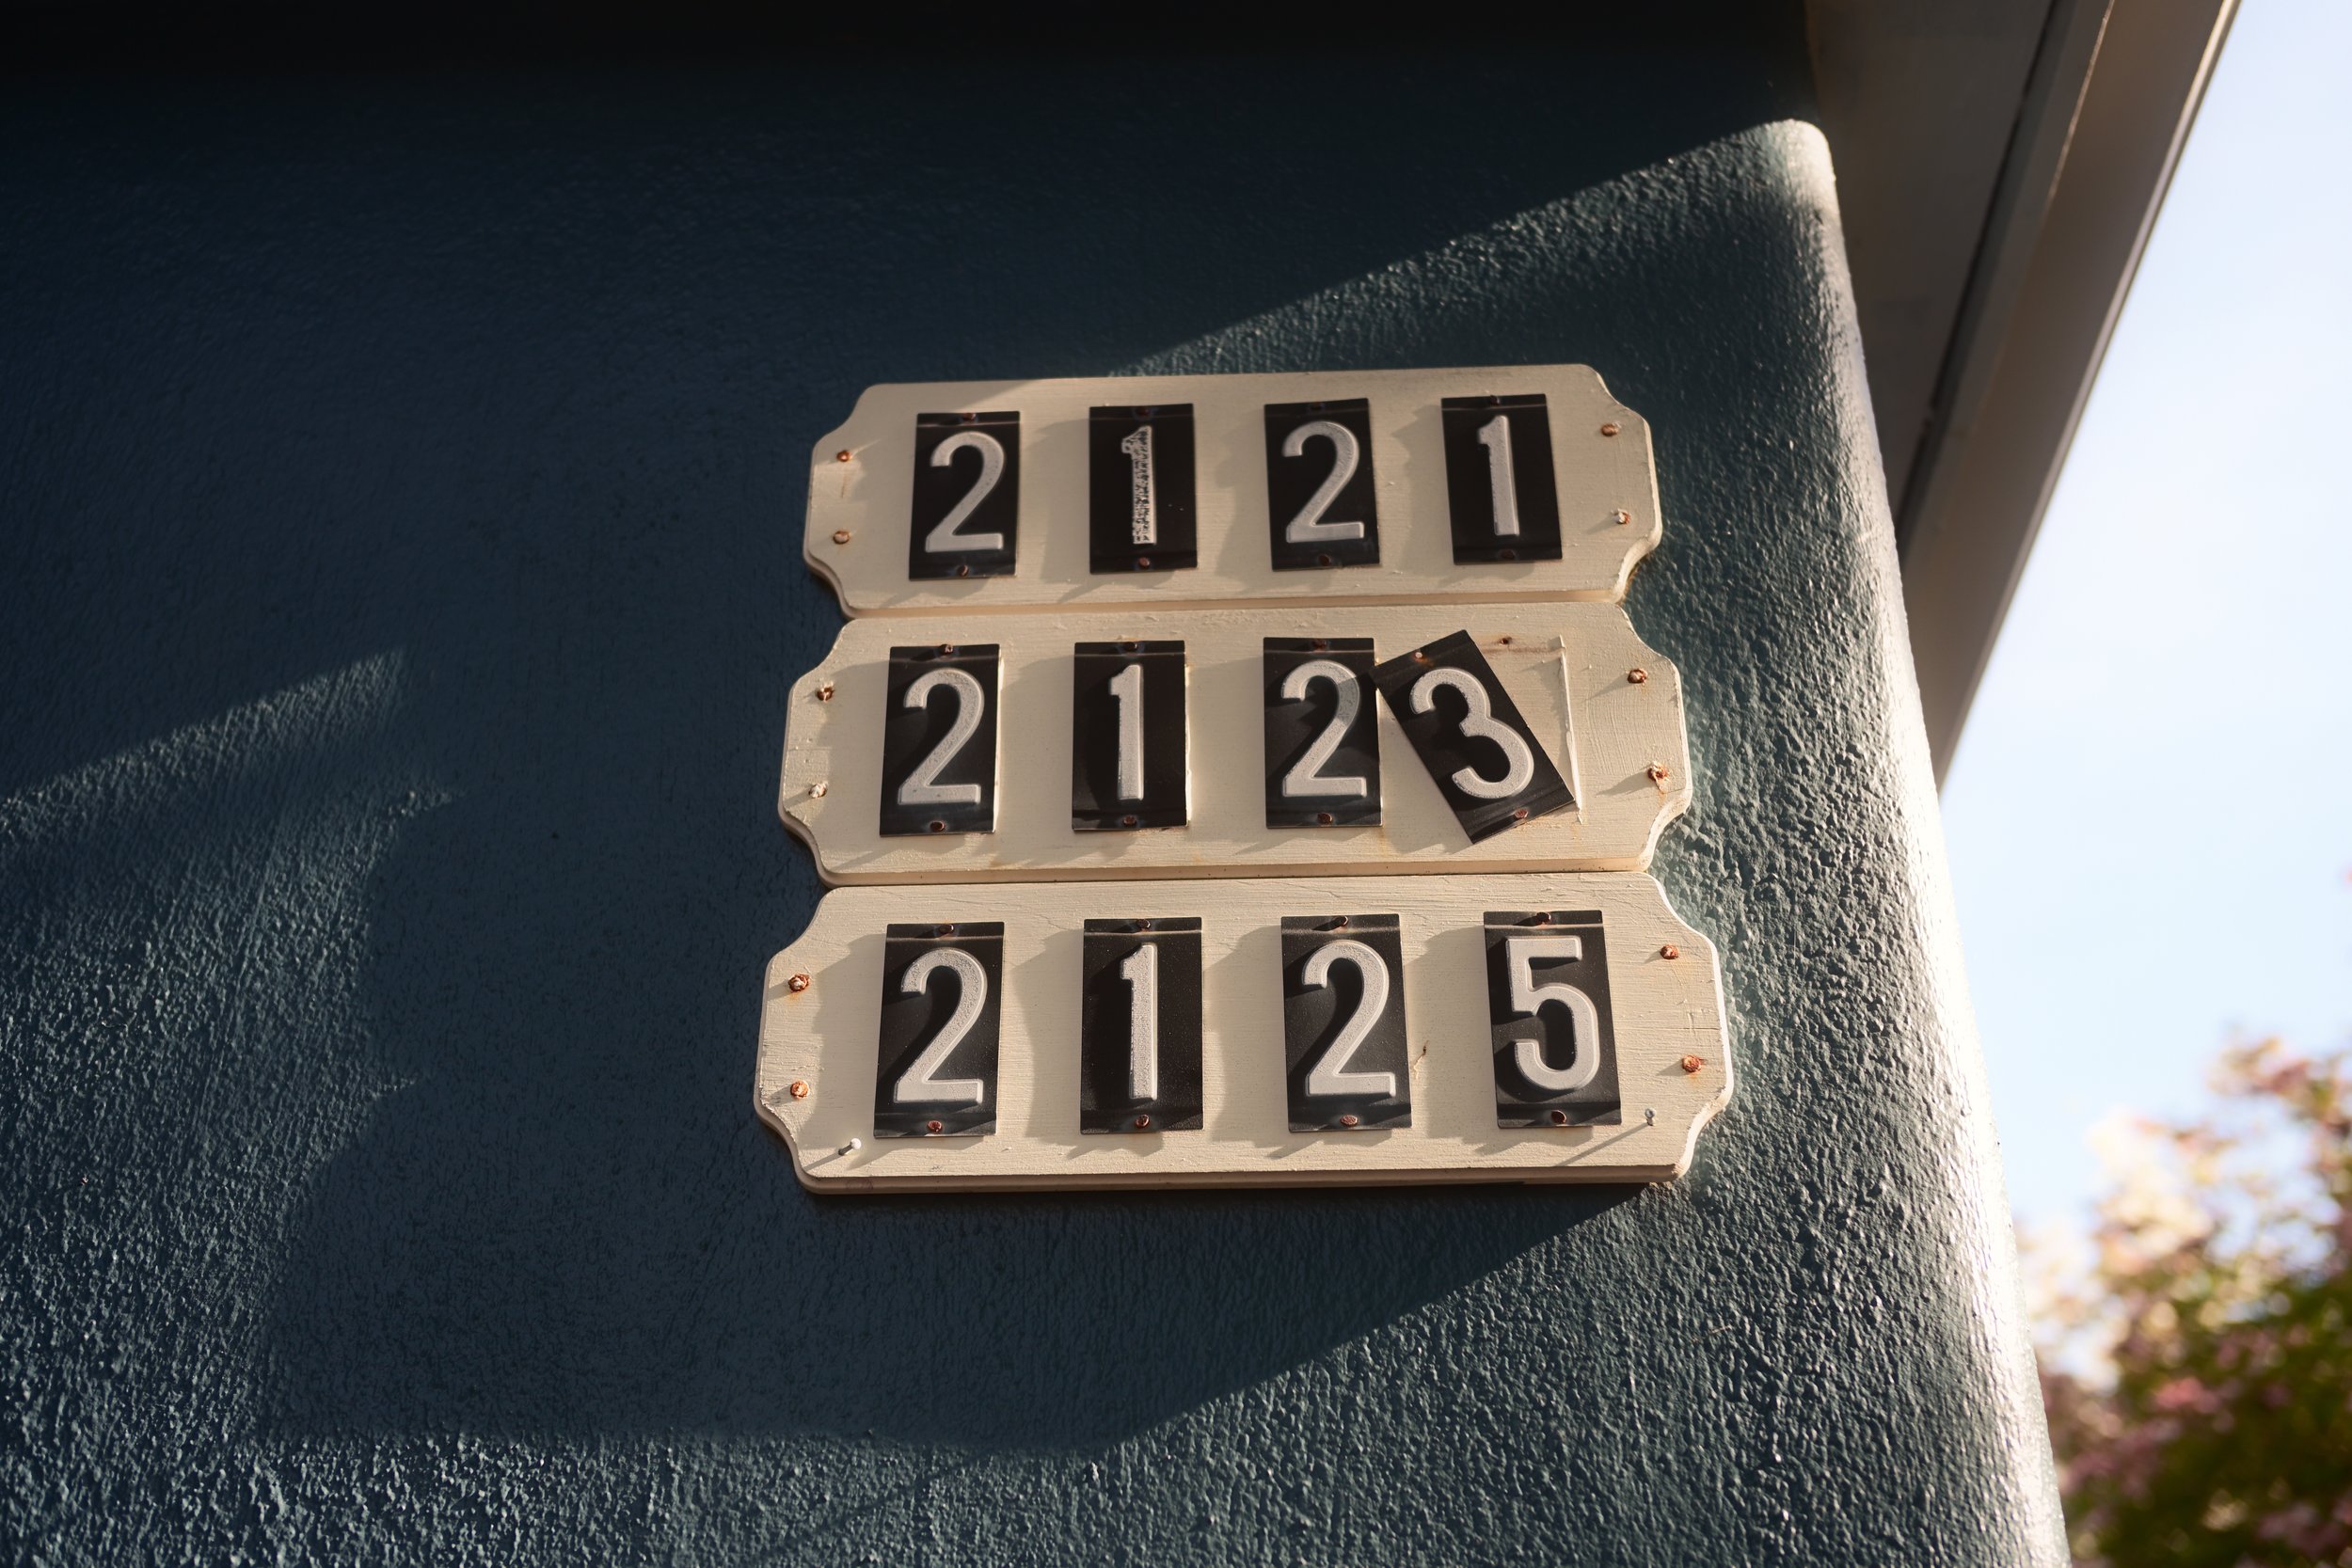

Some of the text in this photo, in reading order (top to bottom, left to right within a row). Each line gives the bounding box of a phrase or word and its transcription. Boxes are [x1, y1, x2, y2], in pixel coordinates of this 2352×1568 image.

[925, 415, 1521, 553] 2121
[897, 660, 1535, 805] 2123
[895, 936, 1601, 1105] 2125
